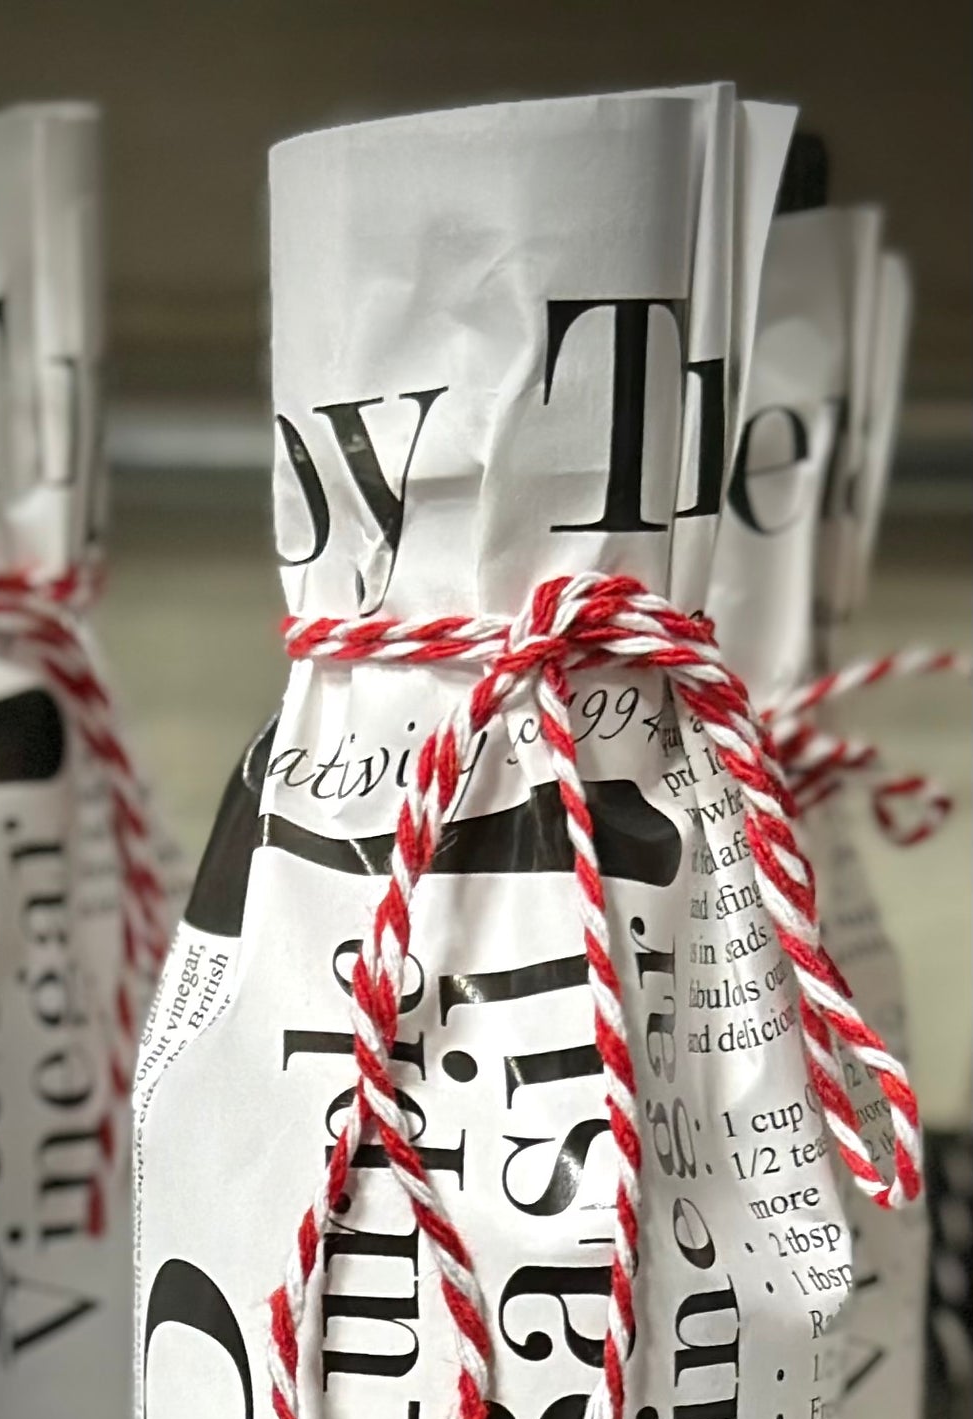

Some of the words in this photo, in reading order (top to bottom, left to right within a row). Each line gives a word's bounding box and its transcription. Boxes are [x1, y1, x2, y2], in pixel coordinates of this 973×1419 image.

[167, 944, 207, 1031] vinegar,
[189, 953, 230, 1031] British
[749, 1100, 805, 1132] cup
[730, 1146, 782, 1181] 1/2
[747, 1185, 821, 1220] more
